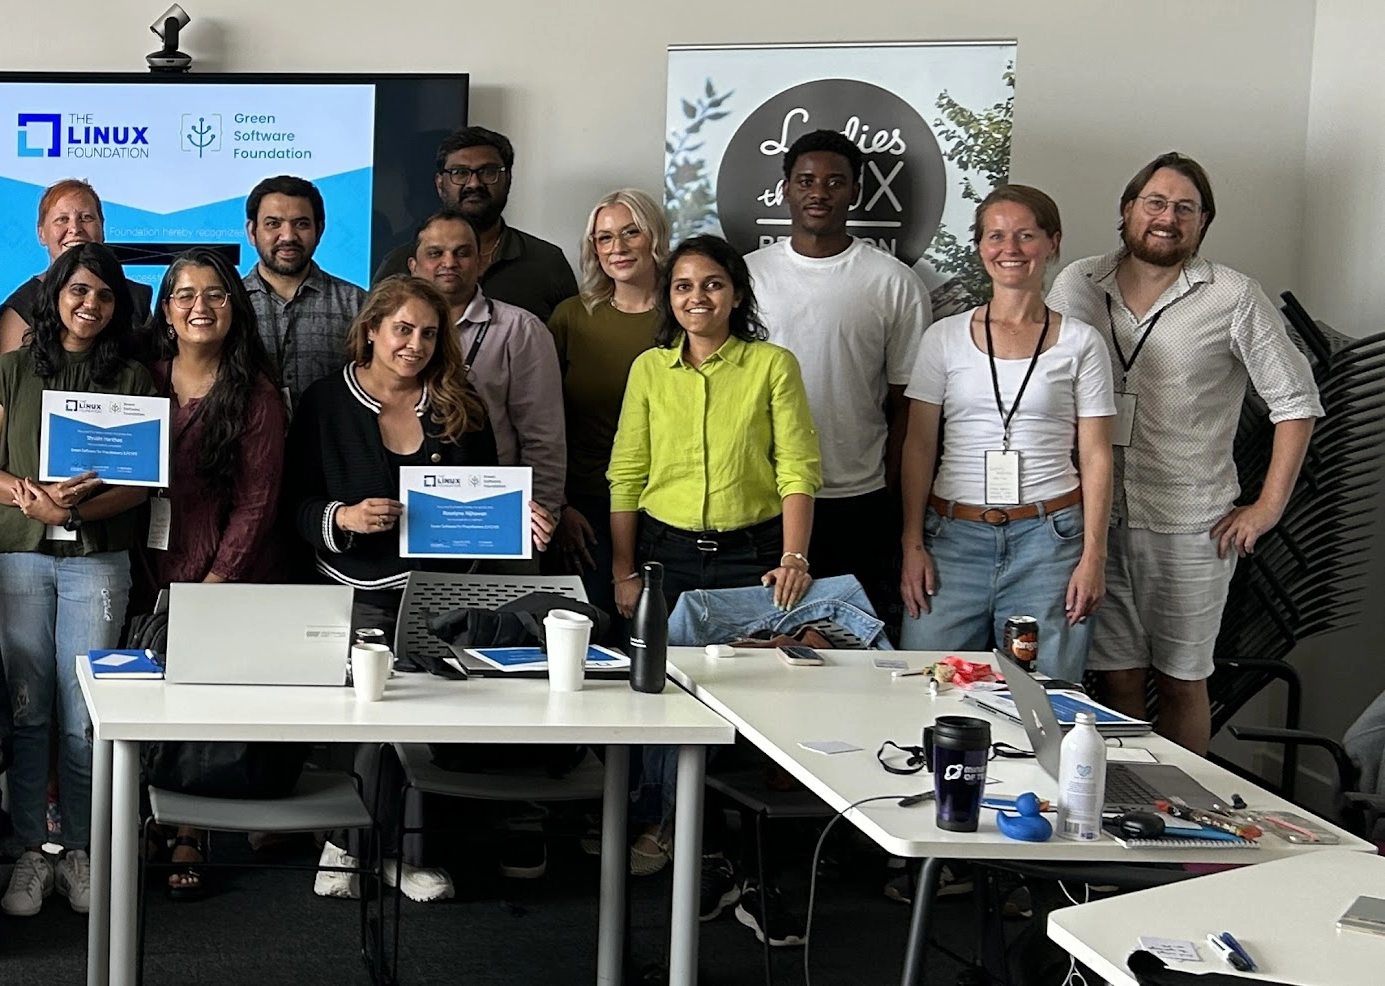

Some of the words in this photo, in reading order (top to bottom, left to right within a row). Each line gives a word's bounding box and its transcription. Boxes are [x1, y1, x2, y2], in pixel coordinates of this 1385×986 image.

[68, 113, 94, 124] THE
[234, 113, 276, 124] Green
[68, 126, 149, 145] LINUX
[234, 129, 296, 142] Software
[67, 147, 149, 159] FOUNDATION
[233, 147, 312, 160] Foundation
[109, 226, 160, 237] Foundation
[162, 227, 193, 239] hereby
[79, 402, 102, 410] LINUX
